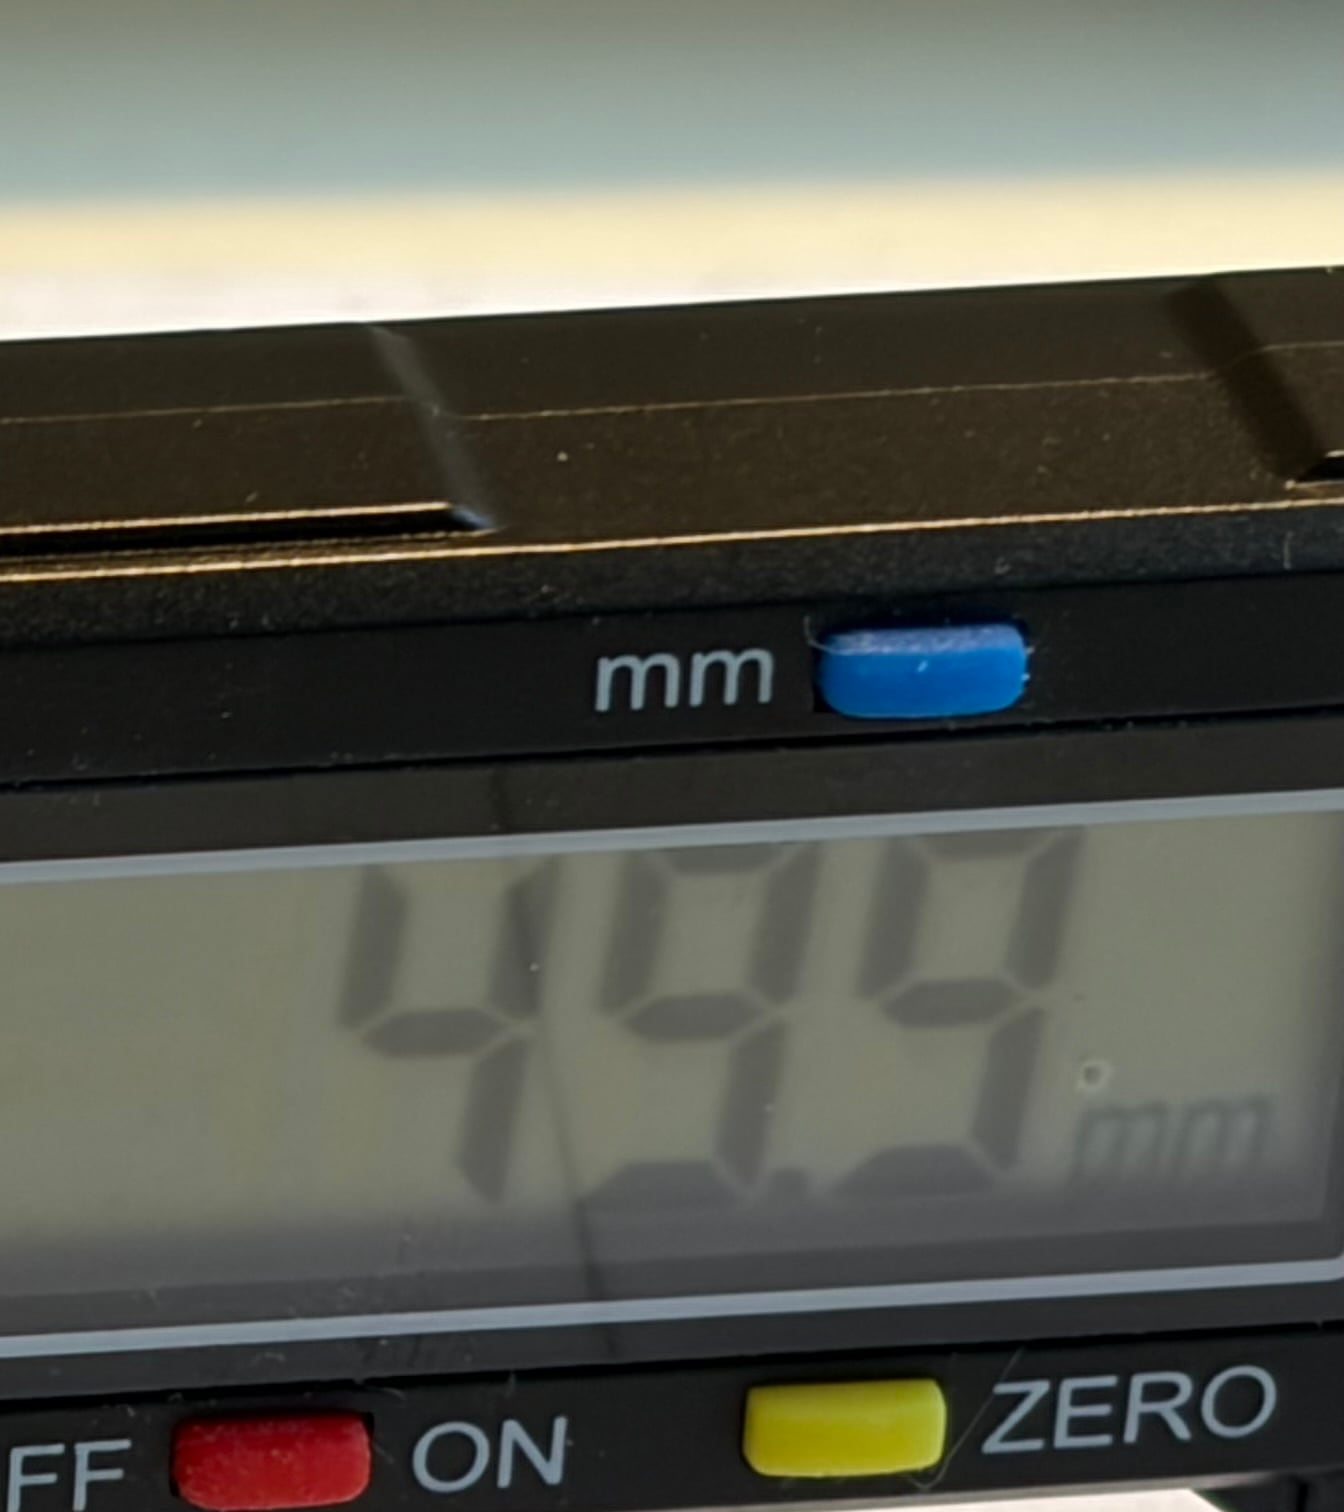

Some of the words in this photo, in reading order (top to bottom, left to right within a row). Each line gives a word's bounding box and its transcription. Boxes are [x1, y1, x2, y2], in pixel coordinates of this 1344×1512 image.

[594, 647, 775, 713] mm
[980, 1364, 1279, 1456] ZERO
[410, 1415, 569, 1493] ON
